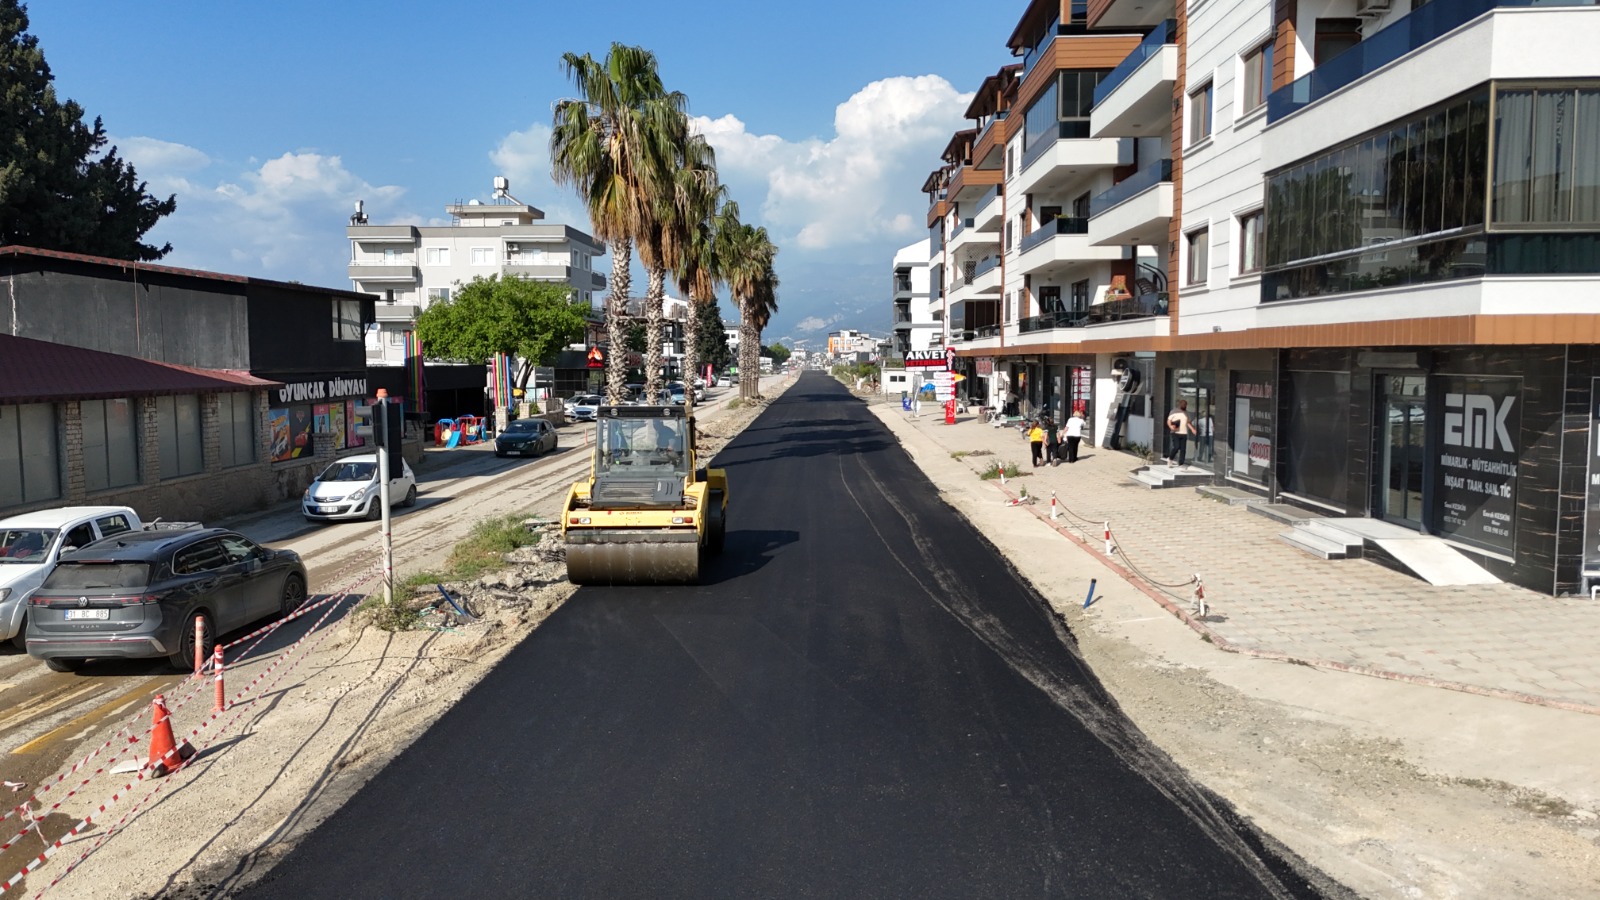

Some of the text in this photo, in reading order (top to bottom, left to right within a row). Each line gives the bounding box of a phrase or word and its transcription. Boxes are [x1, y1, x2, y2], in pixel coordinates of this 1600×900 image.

[906, 350, 946, 360] AKVET
[279, 377, 367, 402] OYUNCAK DÜNYASI
[1444, 393, 1516, 452] EMK
[1440, 453, 1468, 469] MİMARLIK
[1472, 457, 1517, 477] MÜTEAHHİTLİK
[1444, 473, 1465, 489] İNŞAAT
[1500, 483, 1511, 498] TİC
[69, 610, 76, 618] 31
